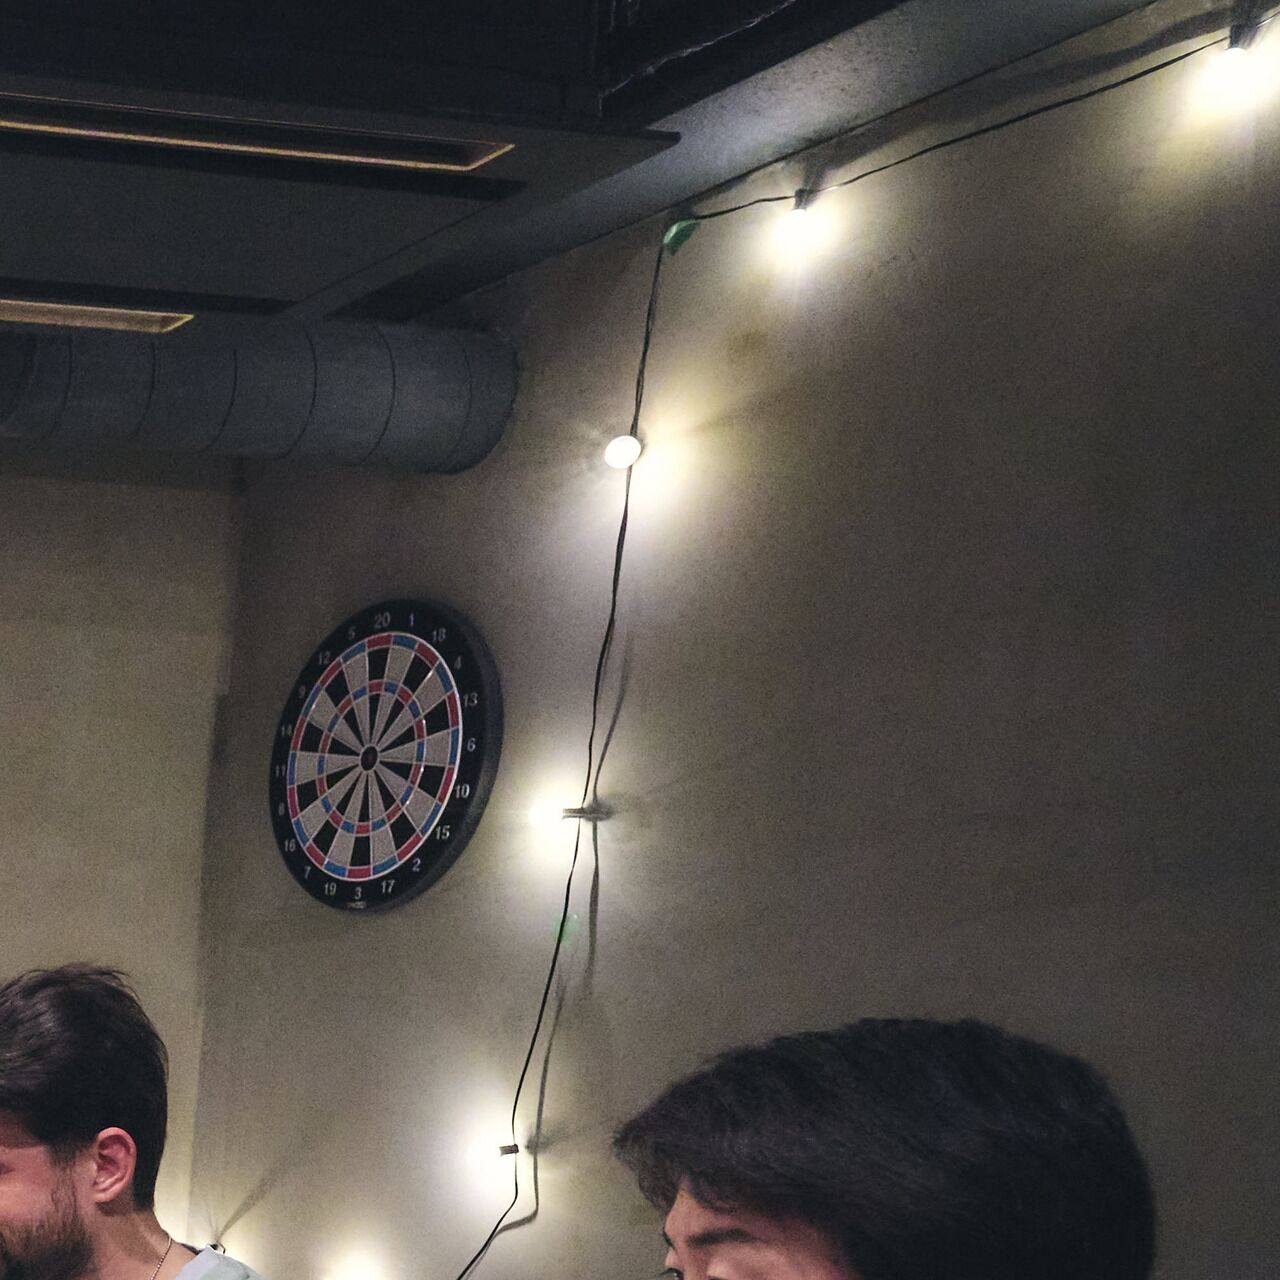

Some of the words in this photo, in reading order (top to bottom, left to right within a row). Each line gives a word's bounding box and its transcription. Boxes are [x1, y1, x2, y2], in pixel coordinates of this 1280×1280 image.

[374, 612, 390, 628] 20
[409, 613, 415, 627] 1
[317, 652, 330, 664] 12
[454, 656, 462, 669] 4
[463, 693, 478, 708] 13
[467, 738, 476, 751] 6
[275, 764, 286, 776] 11
[455, 784, 470, 799] 10
[435, 825, 450, 840] 15
[284, 839, 296, 852] 16
[304, 866, 312, 878] 7
[412, 858, 421, 872] 2
[324, 882, 337, 896] 19
[354, 886, 362, 900] 3
[381, 879, 395, 894] 17
